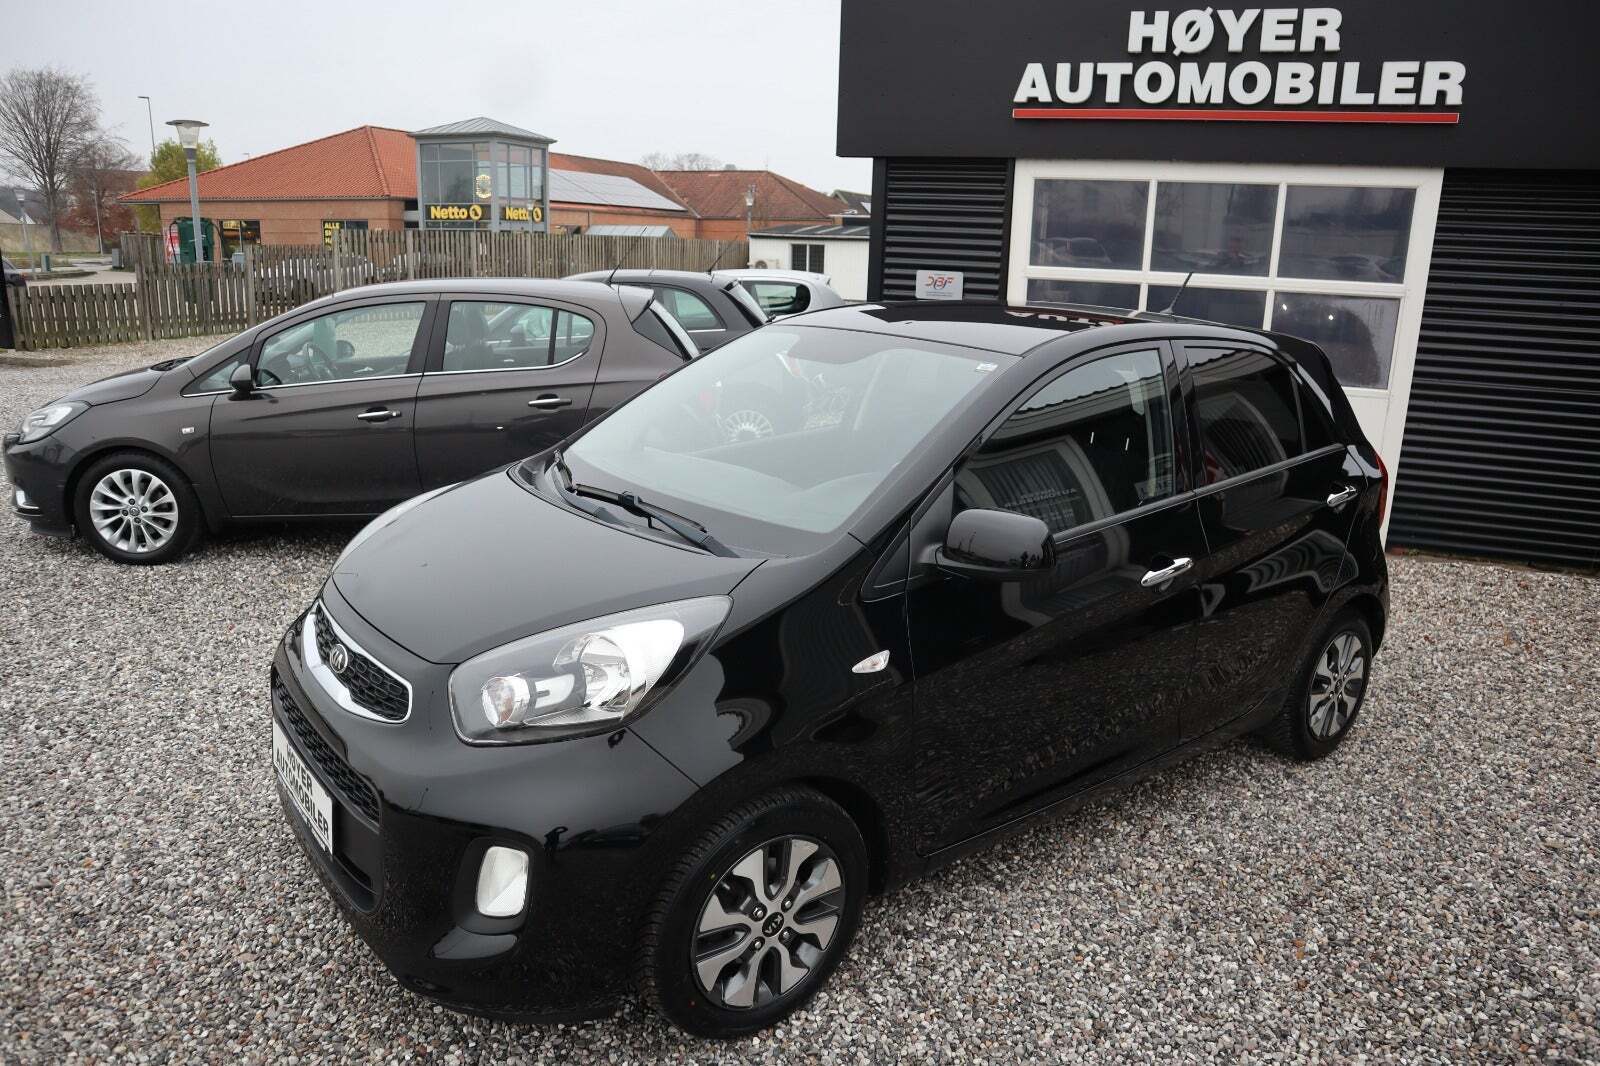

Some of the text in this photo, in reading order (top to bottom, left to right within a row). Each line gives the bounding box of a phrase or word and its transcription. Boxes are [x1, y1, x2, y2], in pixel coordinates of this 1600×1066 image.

[1126, 6, 1344, 57] HØYER
[1012, 59, 1468, 108] AUTOMOBILER
[430, 204, 468, 220] Netto
[276, 747, 330, 841] AUTOMOBILER
